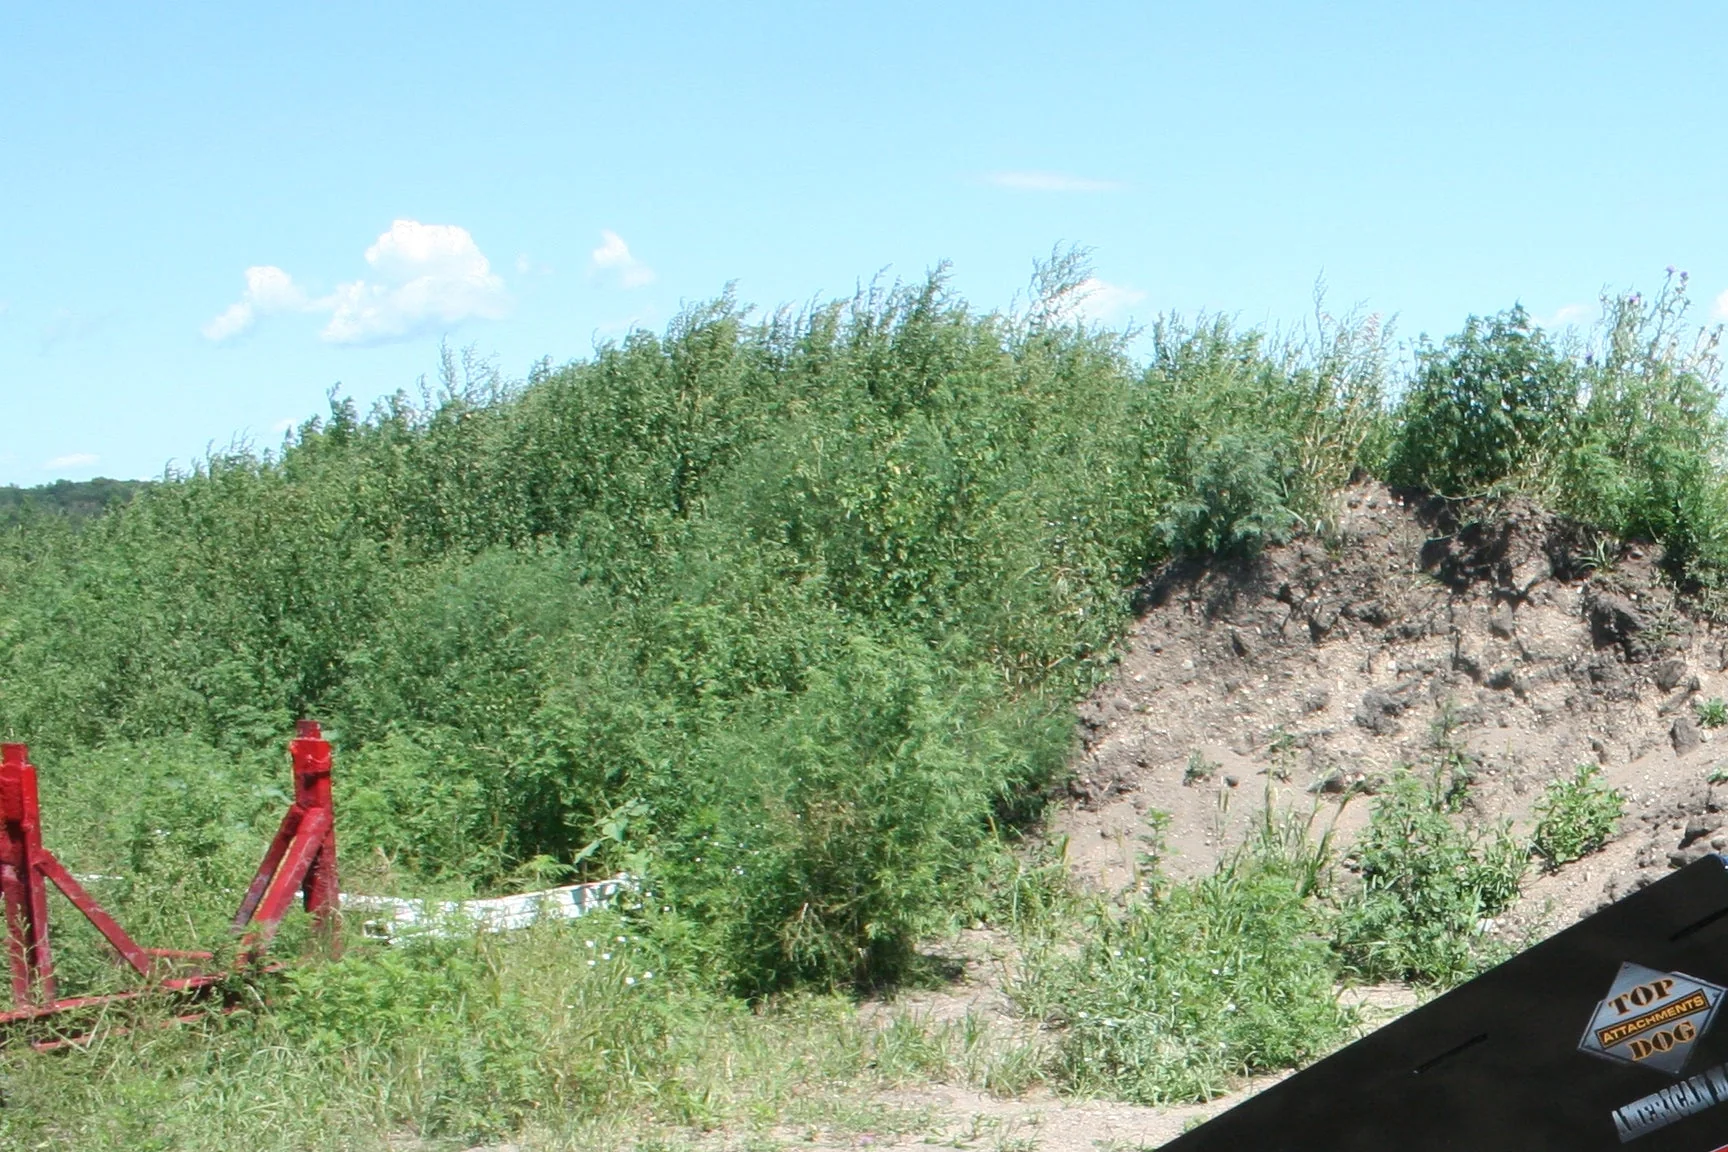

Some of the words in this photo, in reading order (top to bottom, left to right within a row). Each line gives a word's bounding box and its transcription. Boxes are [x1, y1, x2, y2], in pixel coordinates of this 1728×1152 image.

[1603, 996, 1705, 1043] ATTACHMENTS
[1608, 979, 1674, 1016] TOP
[1627, 1020, 1697, 1061] DOG
[1611, 1073, 1716, 1144] AMERICAN
